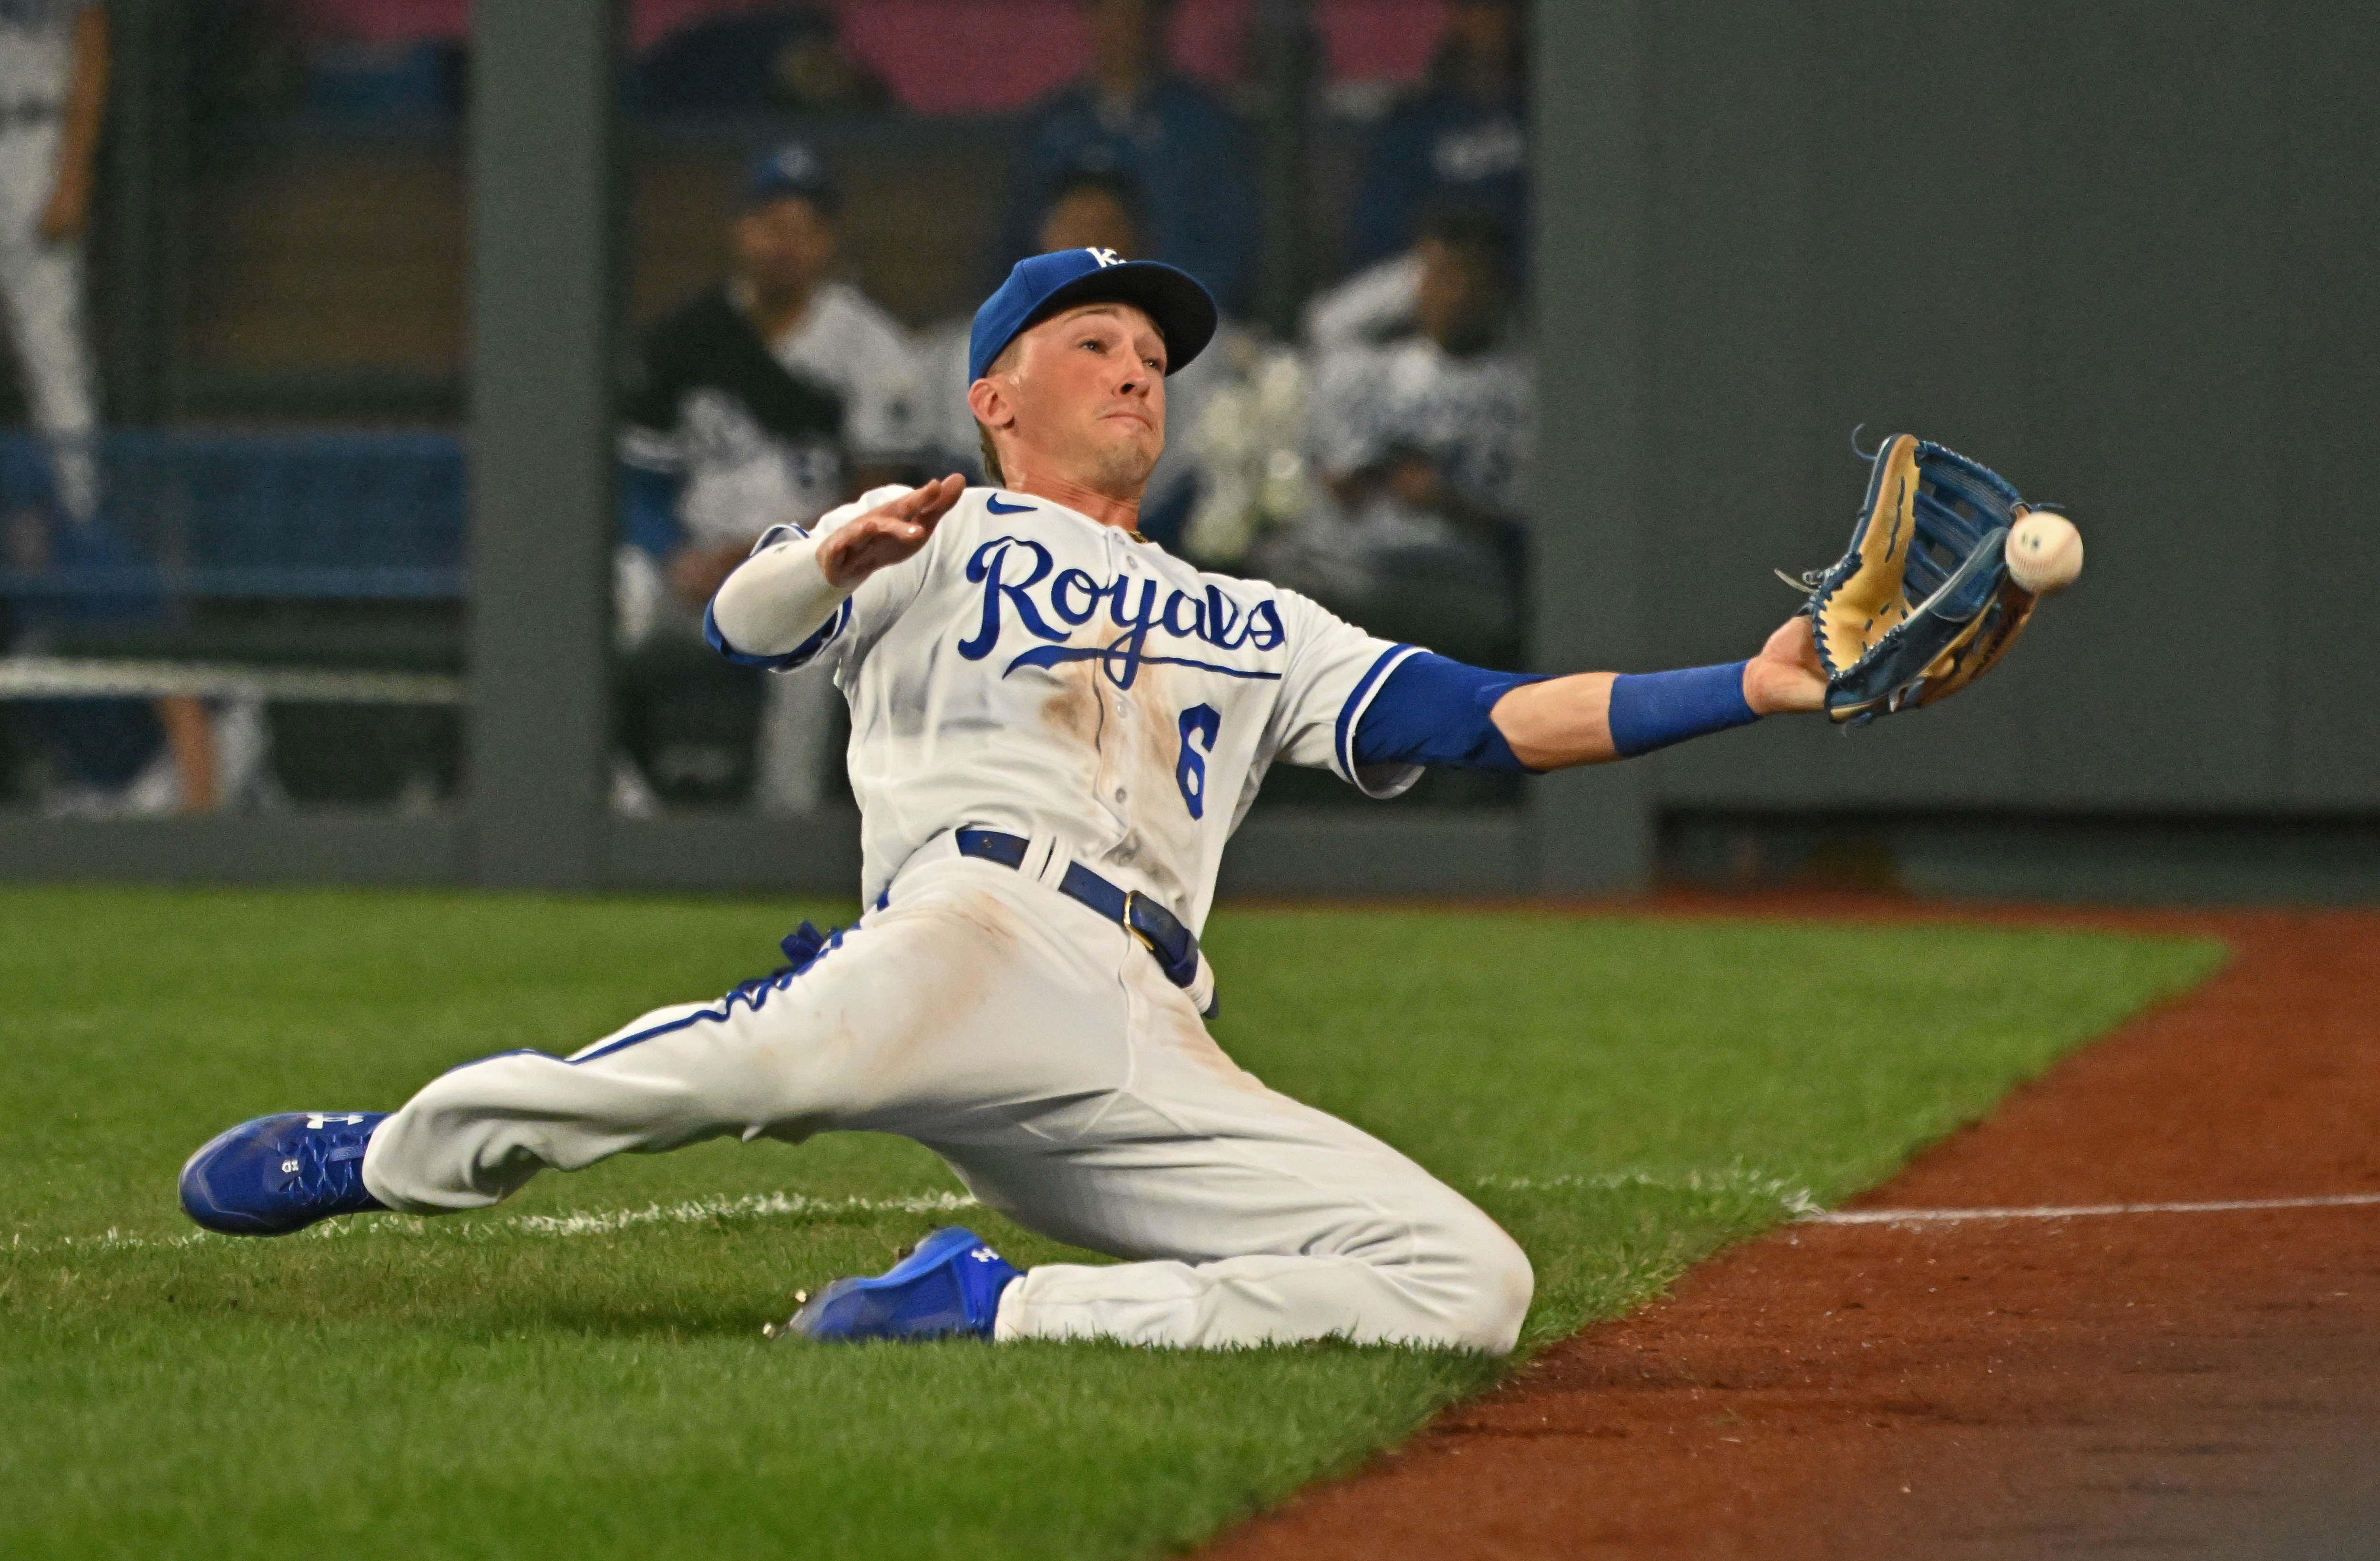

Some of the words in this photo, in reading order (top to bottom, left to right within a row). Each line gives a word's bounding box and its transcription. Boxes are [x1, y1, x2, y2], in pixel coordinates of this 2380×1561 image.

[1086, 247, 1127, 268] K
[958, 536, 1286, 690] Royals
[1176, 703, 1221, 820] 6
